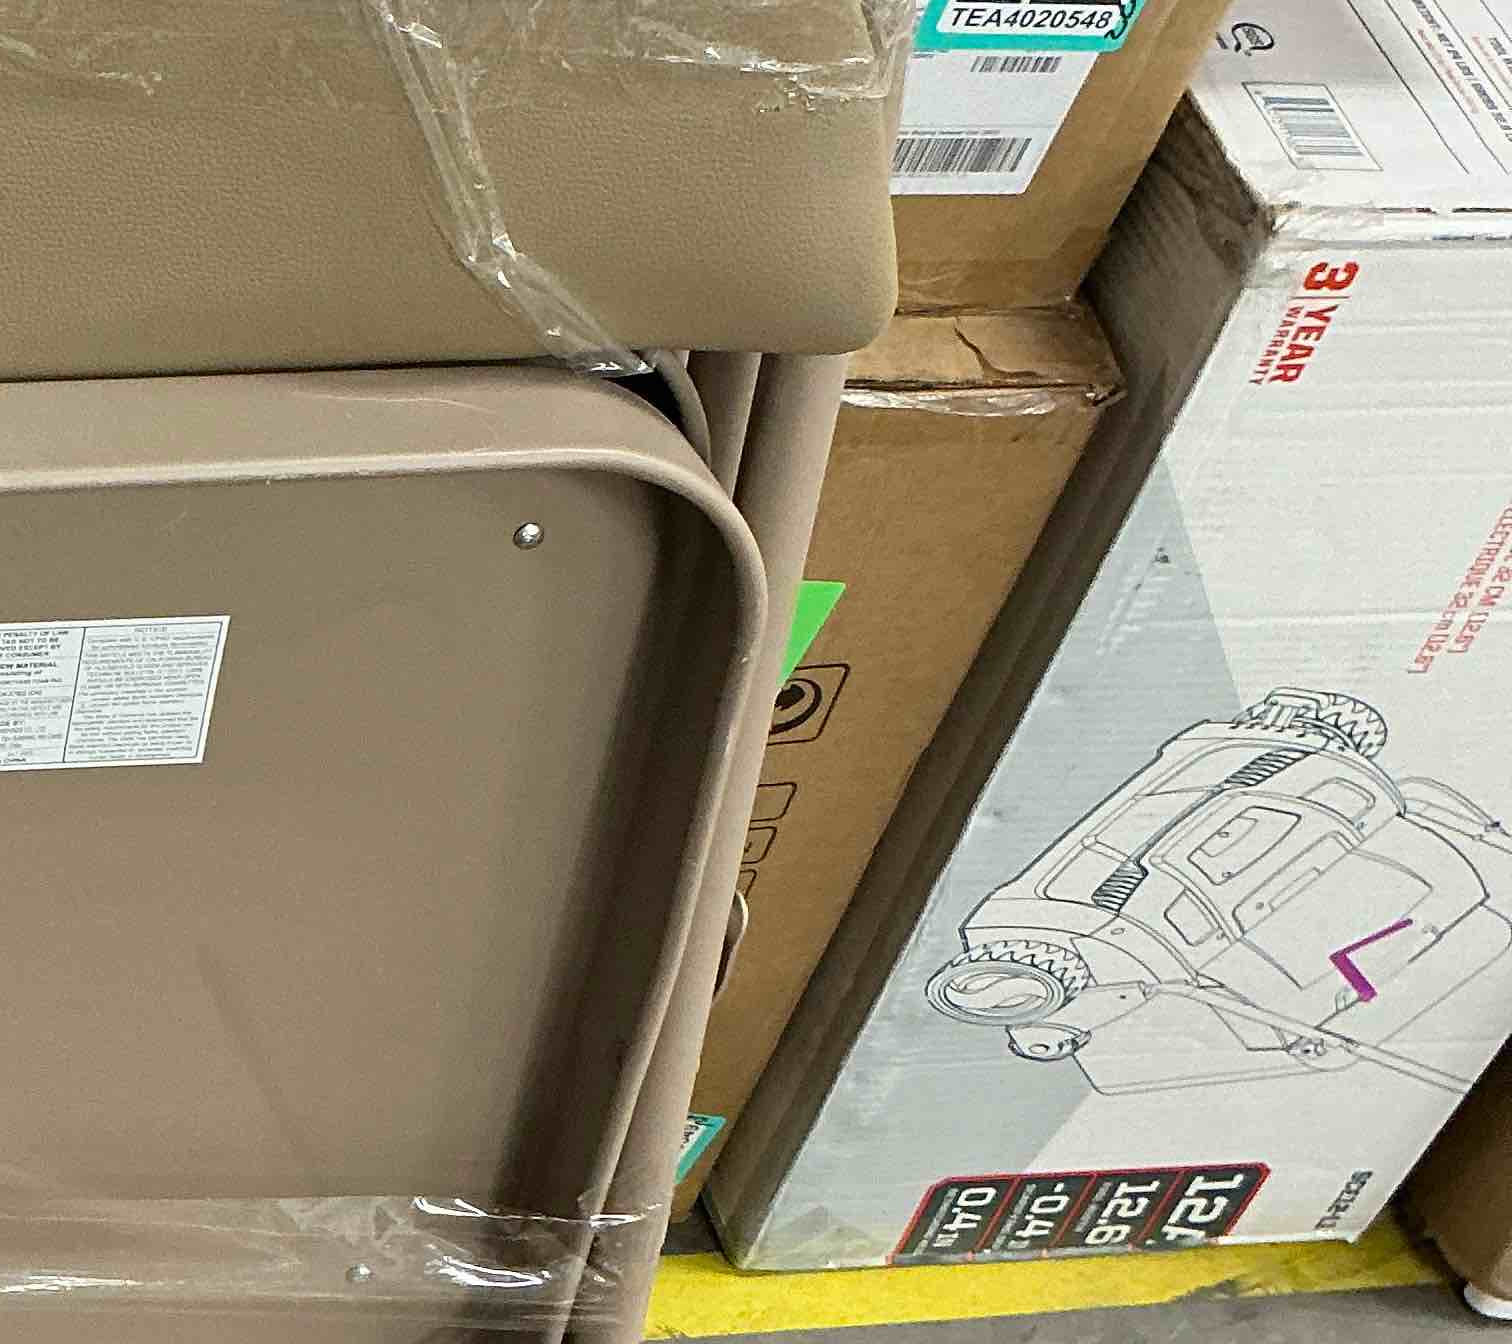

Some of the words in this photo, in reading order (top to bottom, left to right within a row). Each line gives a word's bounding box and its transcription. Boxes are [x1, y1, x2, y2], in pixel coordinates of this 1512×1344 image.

[951, 8, 1113, 29] TEA4020548
[1302, 260, 1361, 292] 3
[1248, 306, 1306, 386] WARRANTY
[1267, 303, 1340, 385] YEAR
[1084, 1179, 1161, 1246] 12.6
